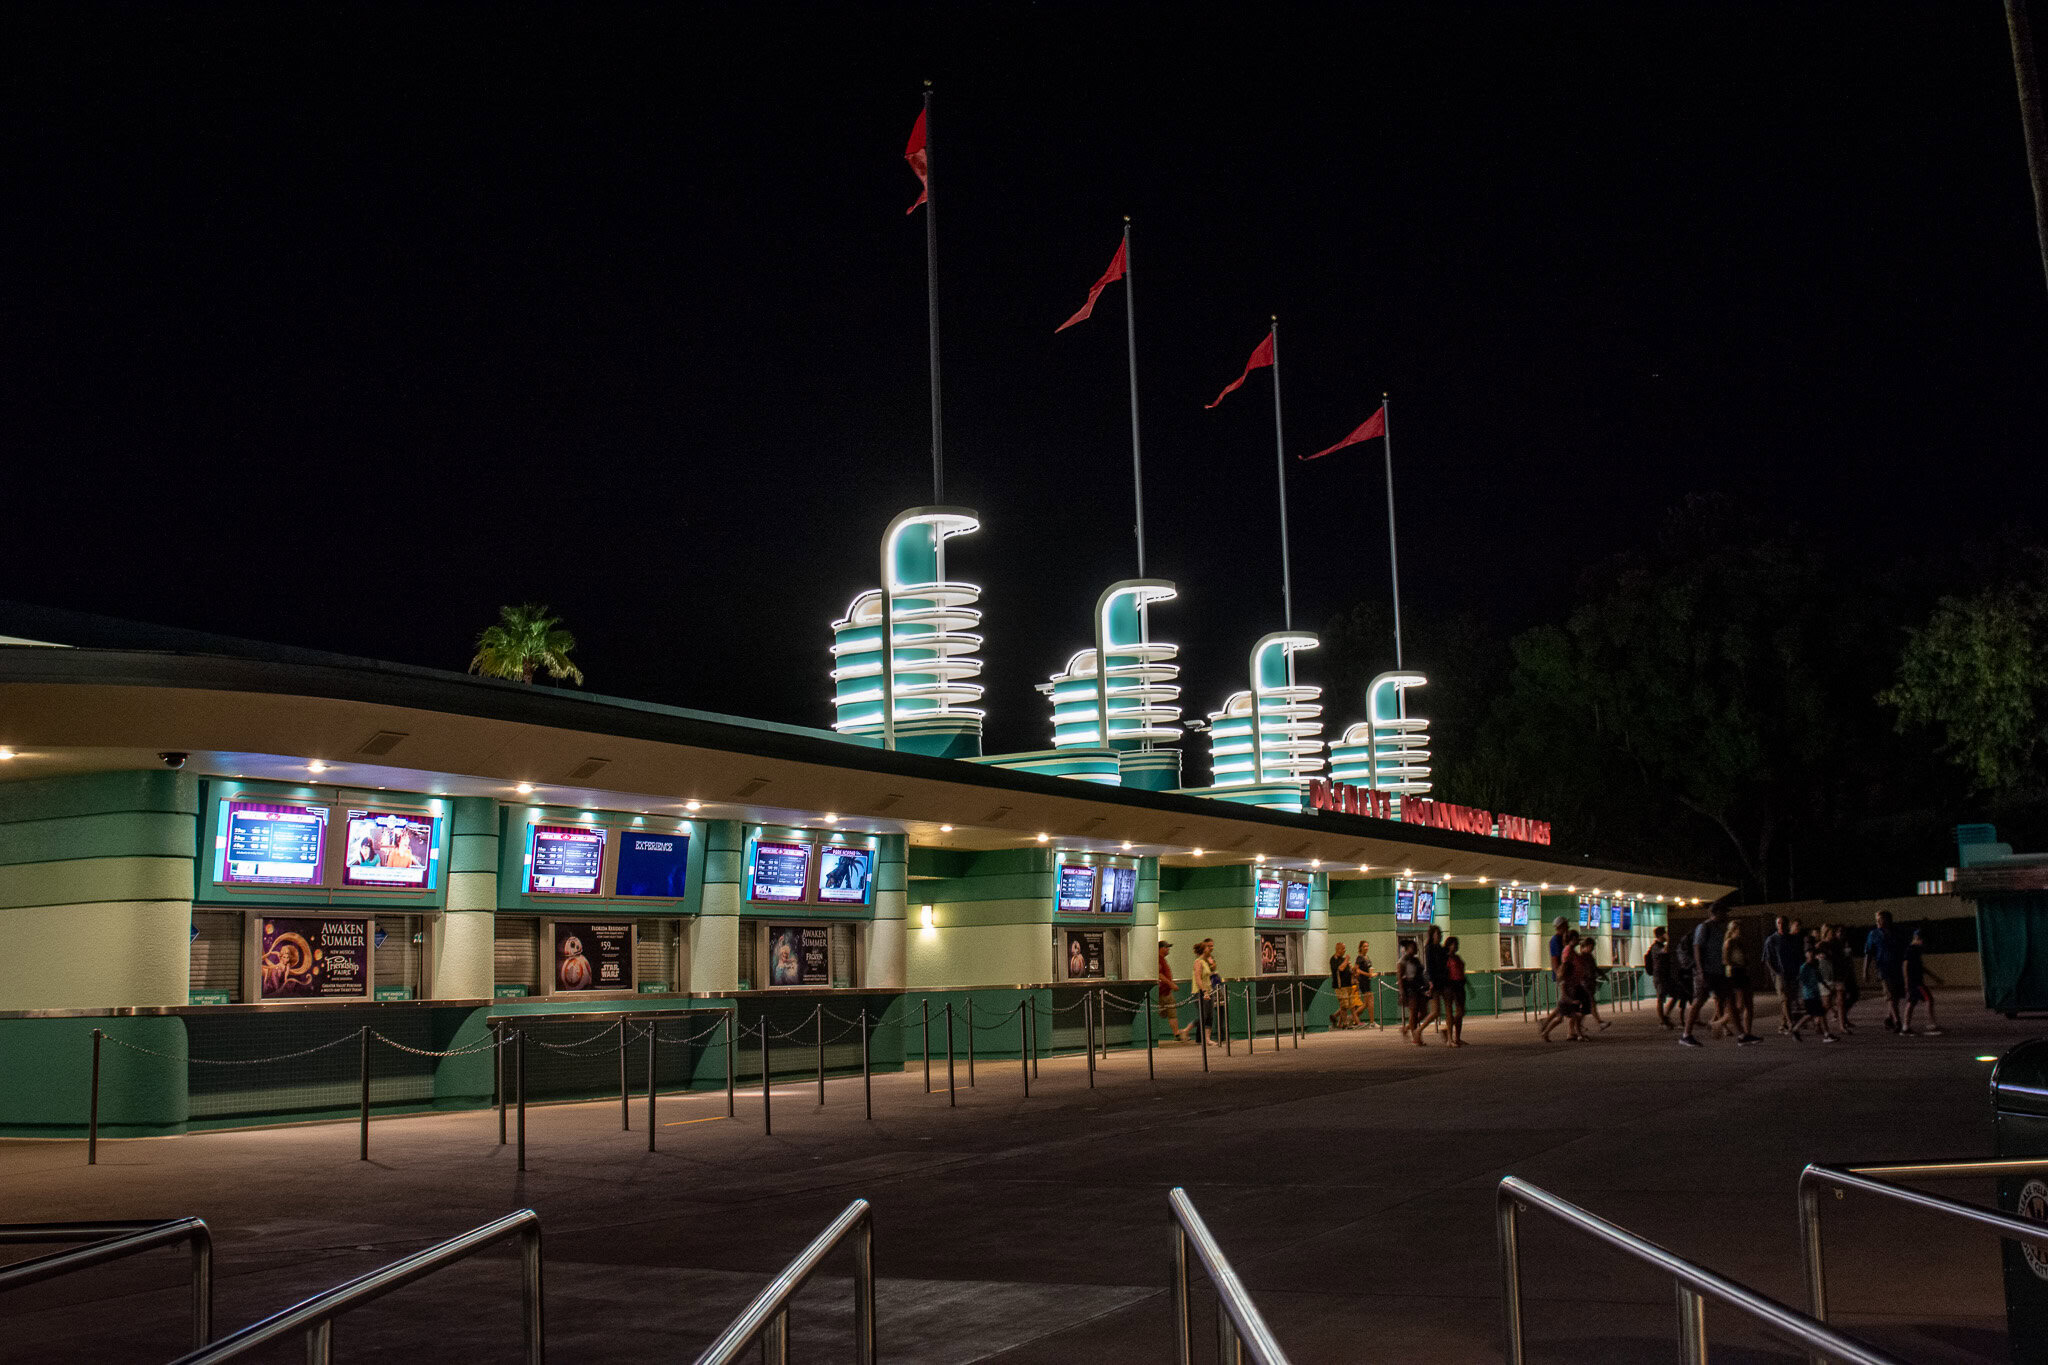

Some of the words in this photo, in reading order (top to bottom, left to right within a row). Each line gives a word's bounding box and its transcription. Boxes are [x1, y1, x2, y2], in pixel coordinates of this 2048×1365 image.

[1401, 794, 1493, 836] HOLLYWOOD
[1498, 813, 1551, 846] STUDIOS
[635, 840, 673, 852] EXPERIENCE
[321, 922, 364, 935] AWAKEN
[802, 929, 827, 938] AWAKEN
[321, 934, 365, 946] SUMMER
[802, 938, 828, 947] SUMMER
[325, 955, 360, 976] Friendship
[601, 970, 620, 978] WARS
